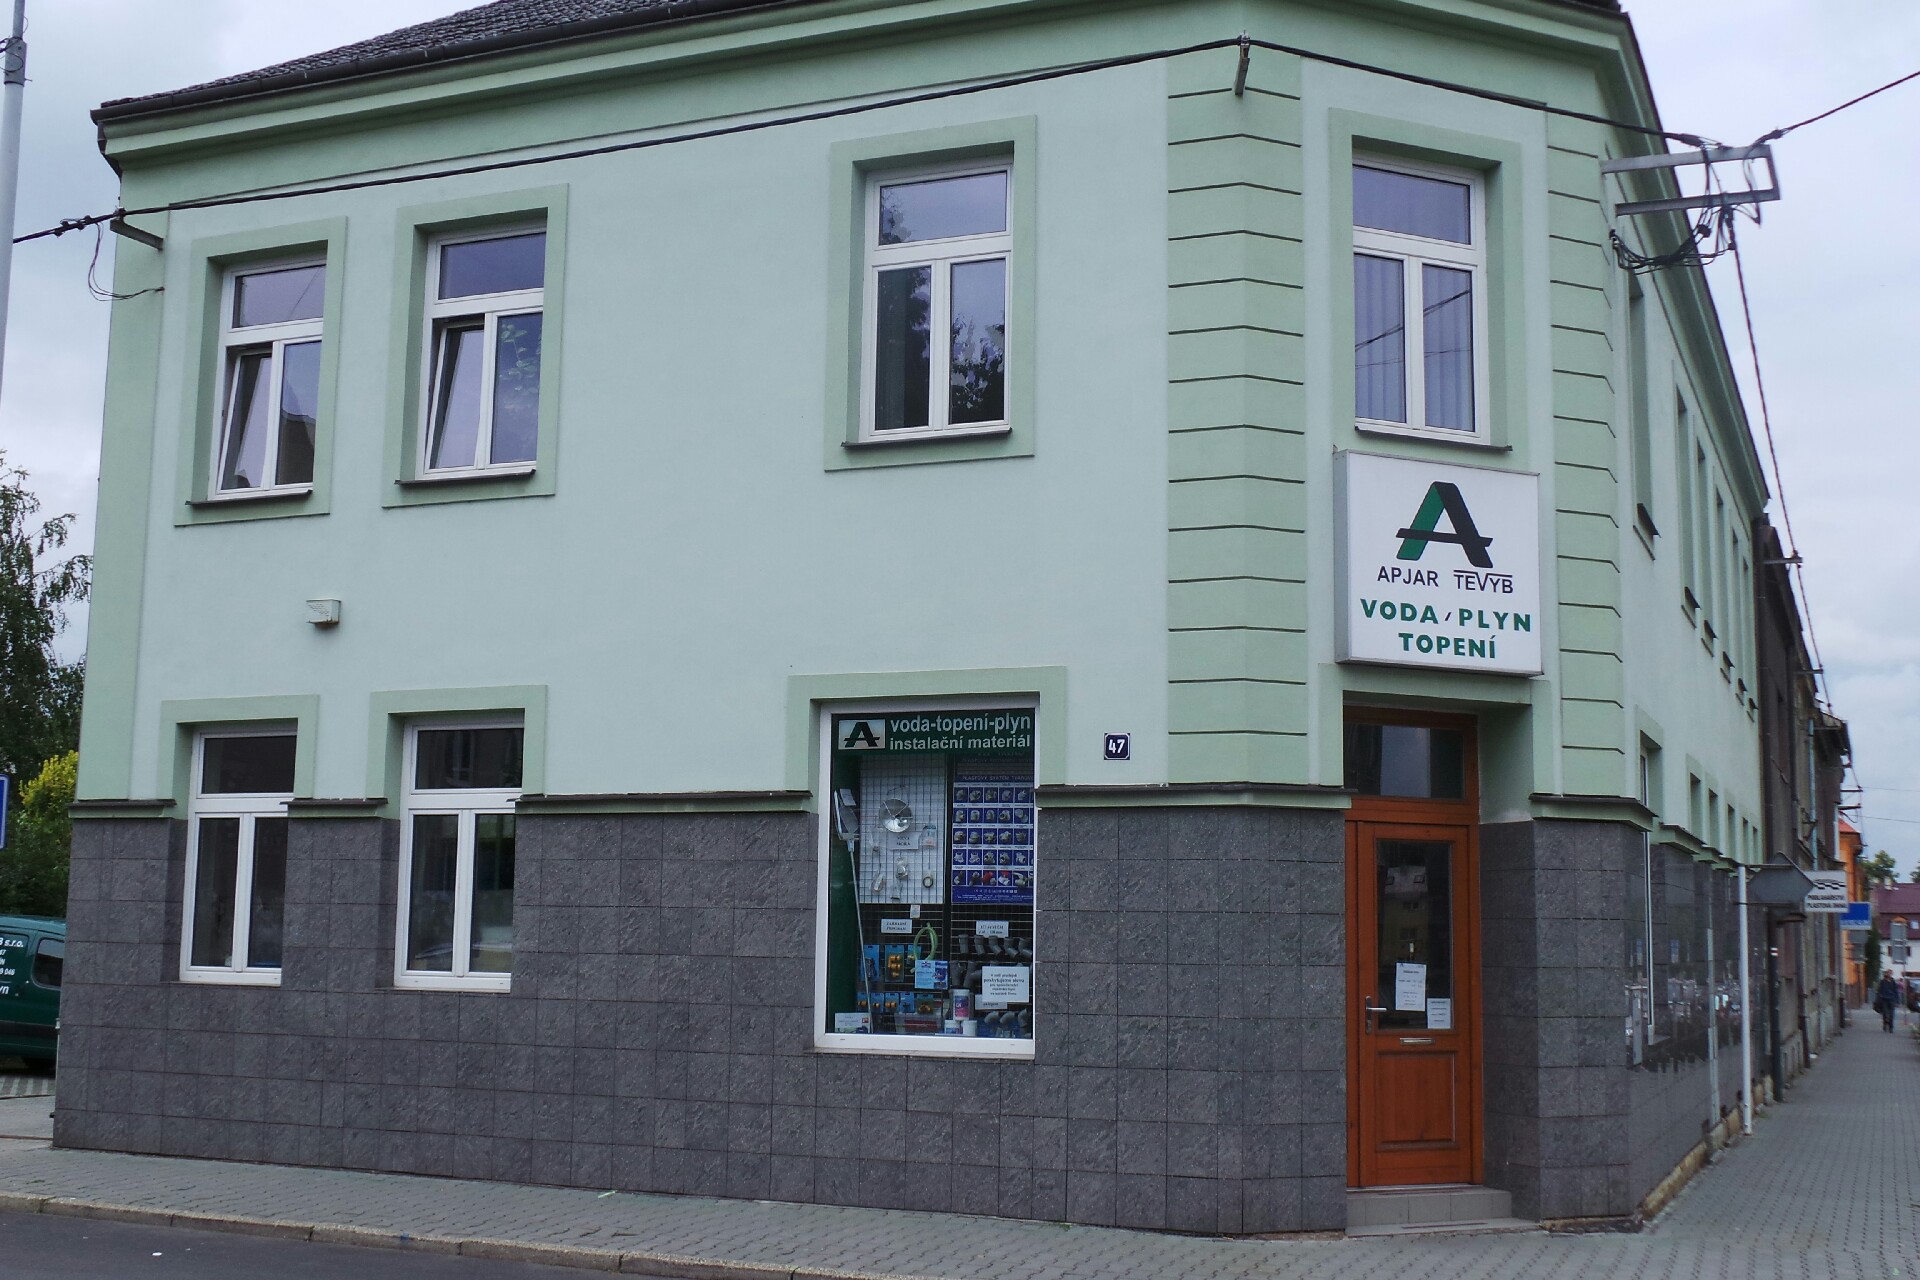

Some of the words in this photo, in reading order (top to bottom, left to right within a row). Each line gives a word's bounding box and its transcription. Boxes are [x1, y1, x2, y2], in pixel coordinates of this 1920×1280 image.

[1377, 566, 1439, 587] APJAR
[1459, 608, 1531, 632] PLYN
[1398, 632, 1496, 659] TOPENÍ
[889, 735, 964, 750] instalační
[967, 734, 1031, 749] materiál
[1108, 738, 1126, 754] 47
[4, 939, 24, 948] s.r.o.
